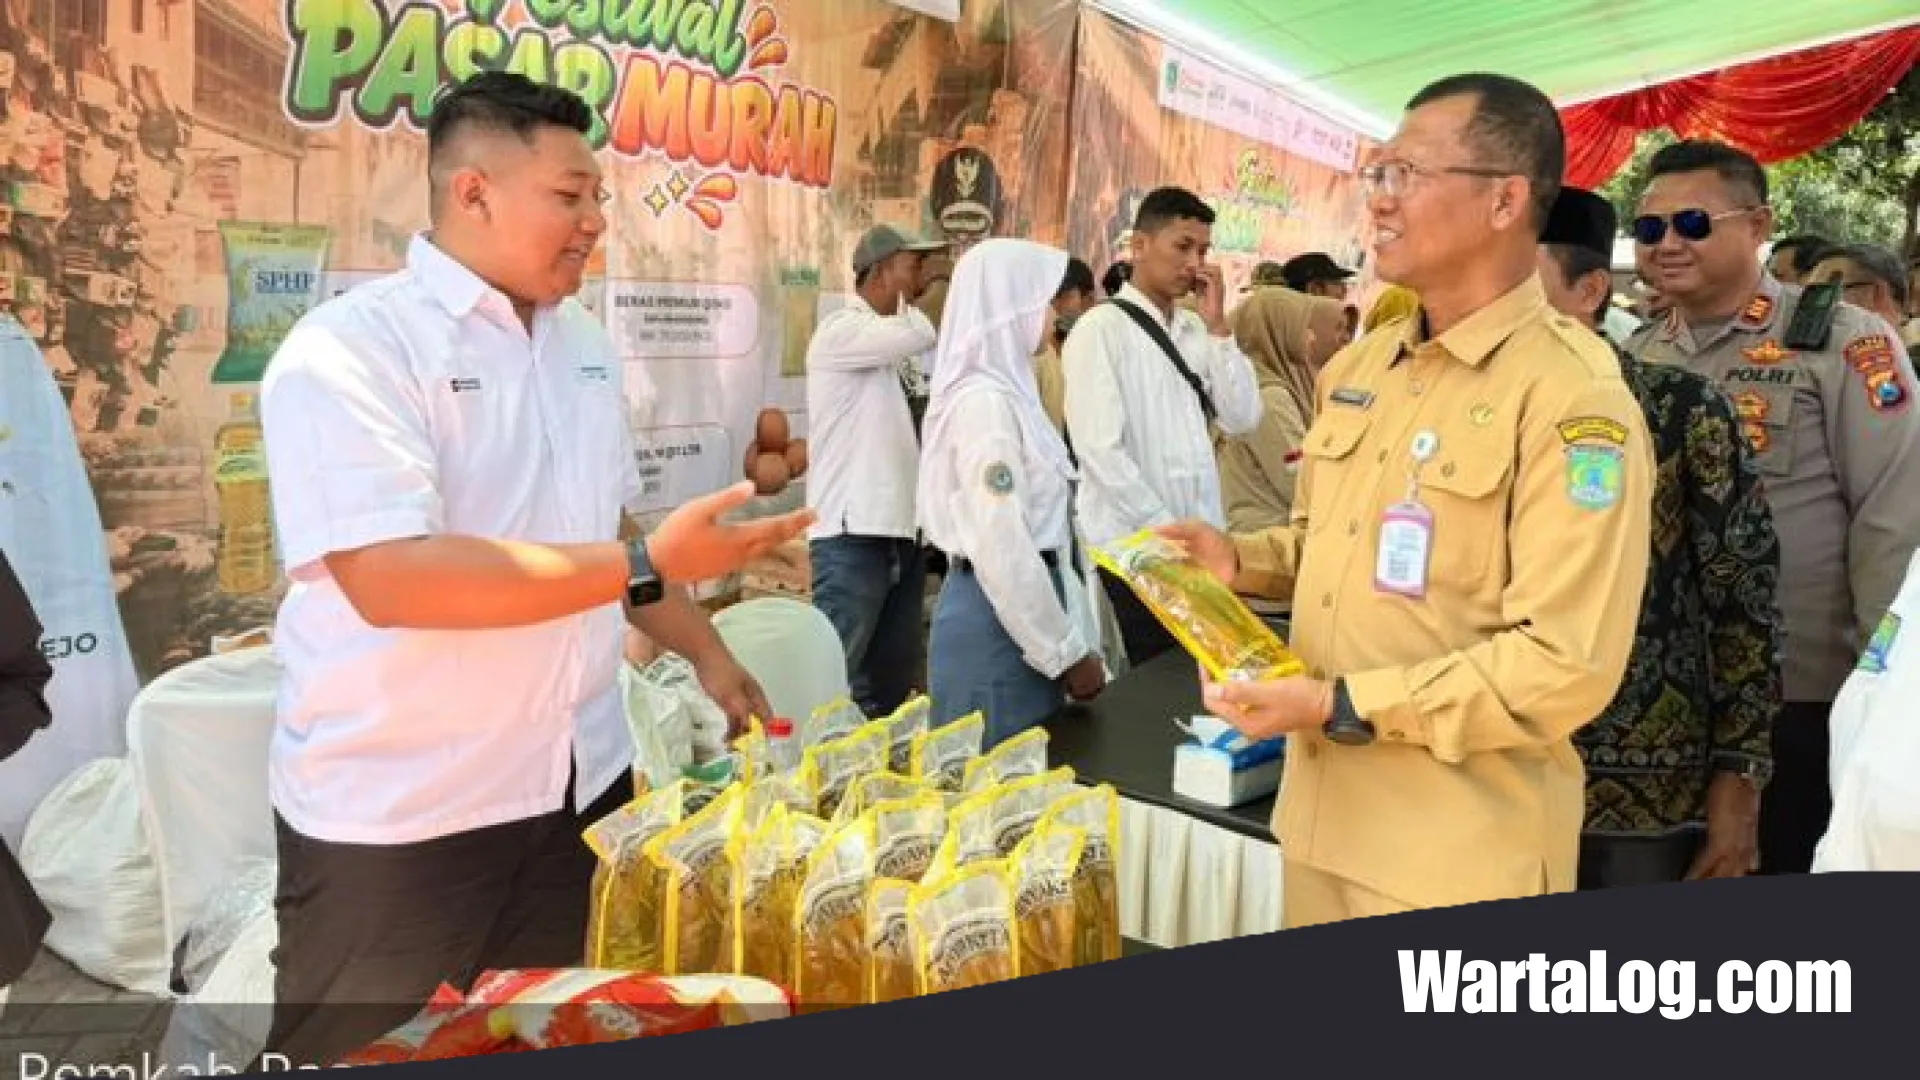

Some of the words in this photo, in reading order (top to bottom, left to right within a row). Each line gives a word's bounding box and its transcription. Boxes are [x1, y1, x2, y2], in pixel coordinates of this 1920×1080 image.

[468, 0, 744, 76] estival
[612, 52, 837, 187] MURAH
[256, 270, 316, 294] SPHP
[1725, 367, 1796, 385] POLRI
